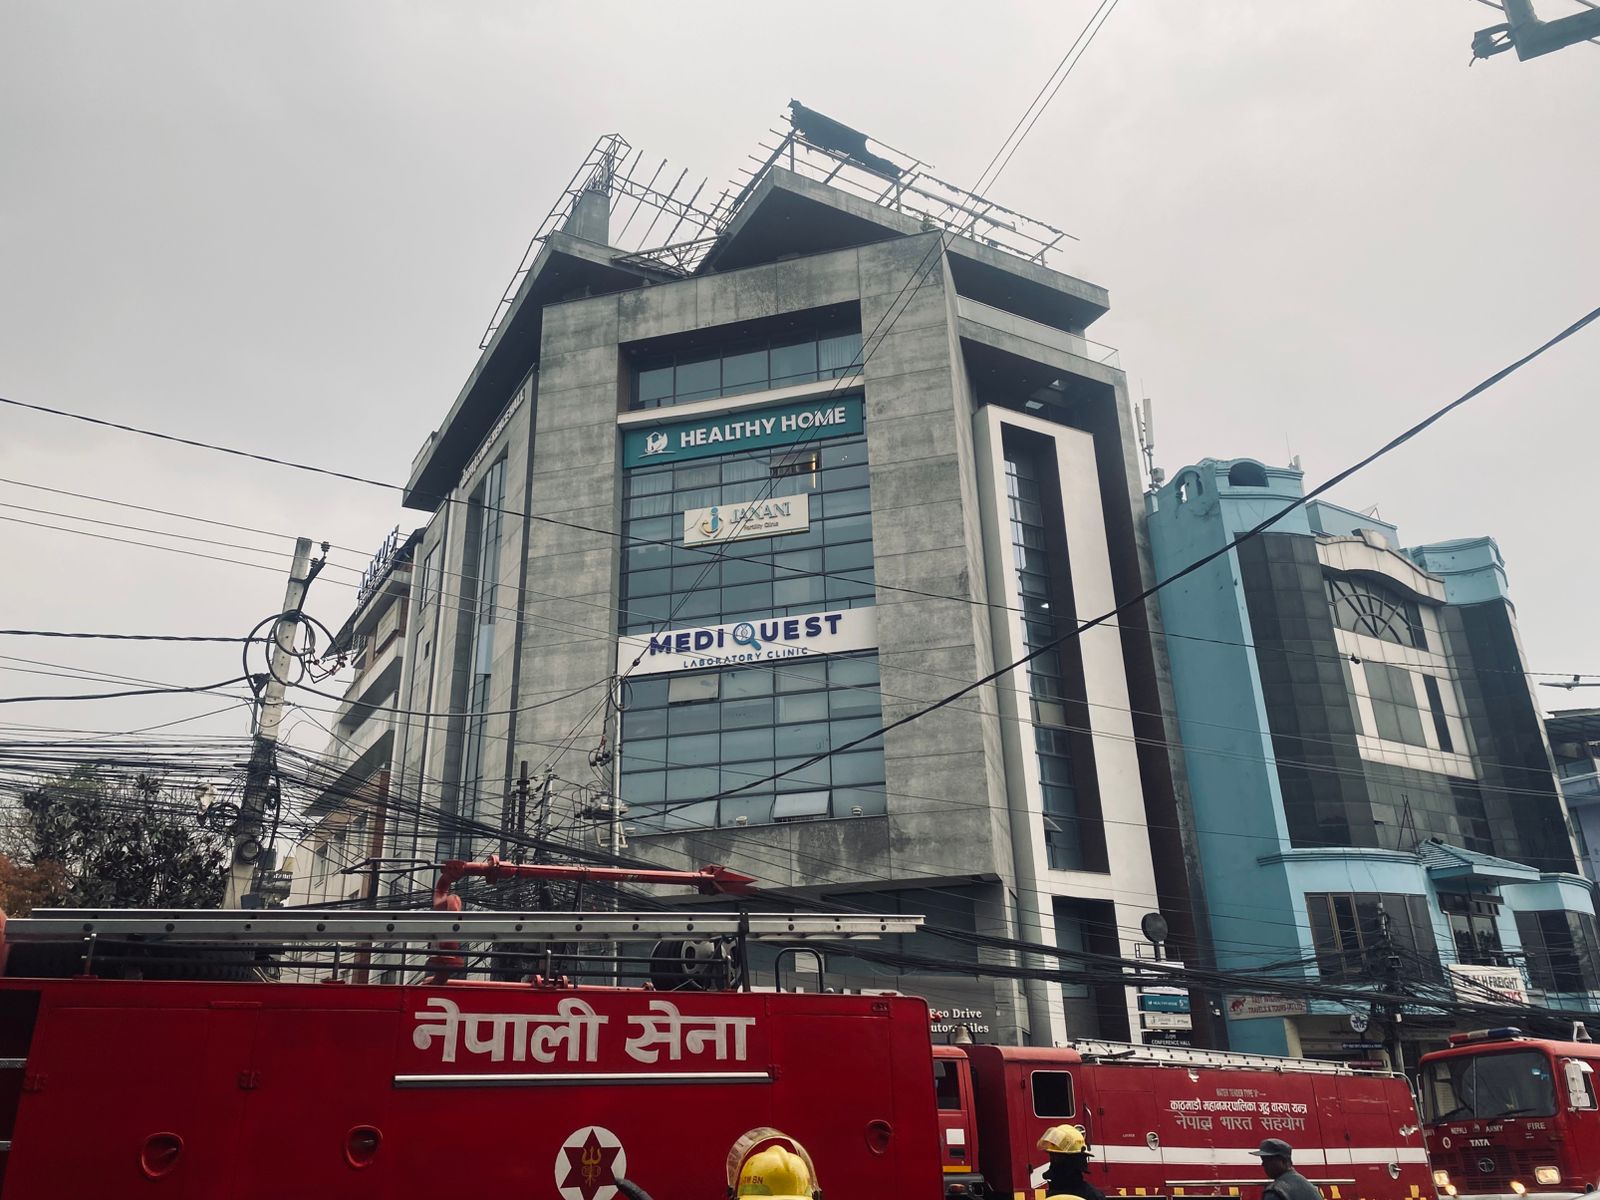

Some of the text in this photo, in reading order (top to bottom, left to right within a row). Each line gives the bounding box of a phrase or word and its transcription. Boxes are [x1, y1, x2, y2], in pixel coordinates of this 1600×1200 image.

[680, 407, 846, 448] HEALTHY HOME
[729, 501, 791, 523] JANANI
[683, 647, 808, 668] LABORATORY CLINIC
[1488, 975, 1518, 989] FREIGHT
[928, 1008, 982, 1019] Eco Drive
[412, 997, 756, 1064] नेपाली सेना
[1220, 1116, 1252, 1130] भारत
[1259, 1113, 1305, 1130] सहयोग
[1450, 1121, 1547, 1135] NEPALI ARMY FIRE
